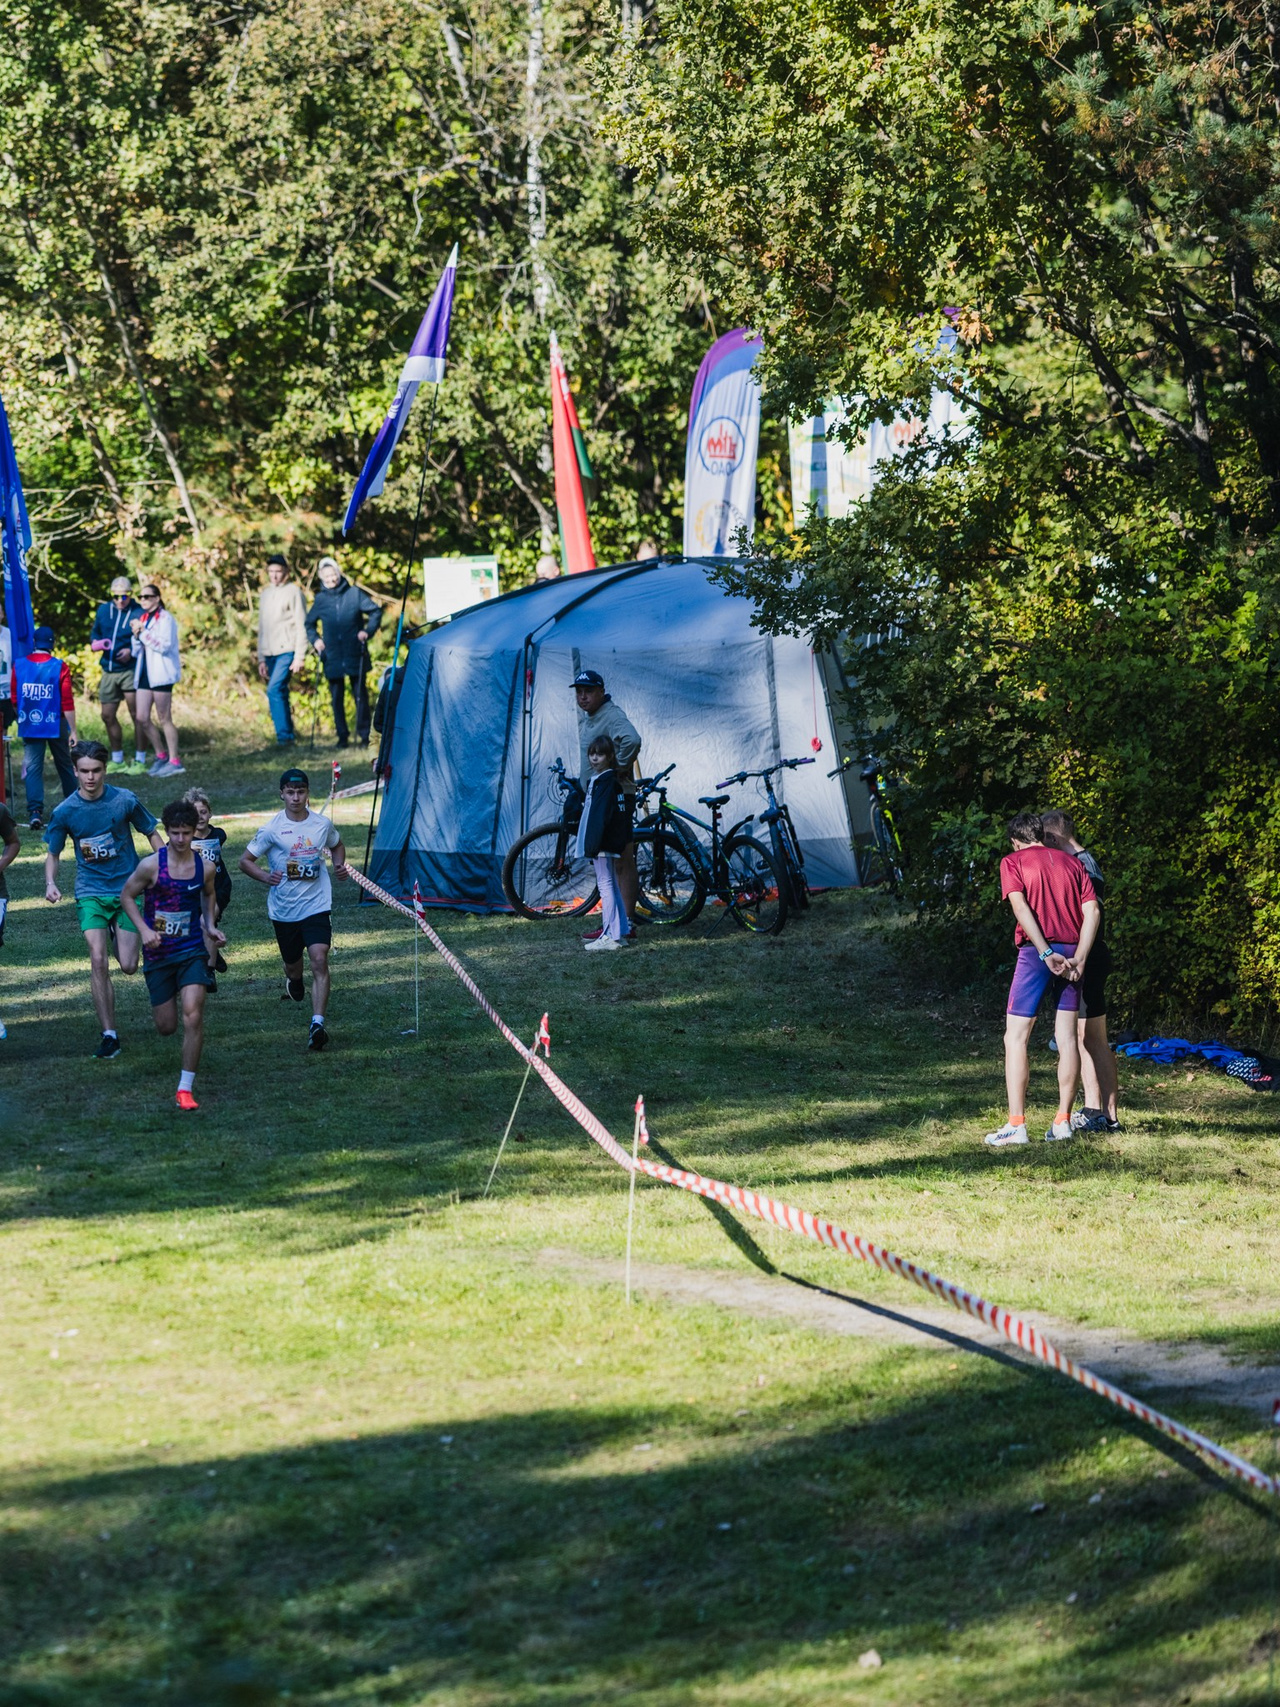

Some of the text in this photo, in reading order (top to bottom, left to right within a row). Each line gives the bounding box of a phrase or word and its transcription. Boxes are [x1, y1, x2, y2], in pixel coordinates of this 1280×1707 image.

[91, 843, 108, 859] 95
[201, 848, 216, 861] 86
[297, 864, 314, 878] 93
[165, 921, 181, 935] 87
